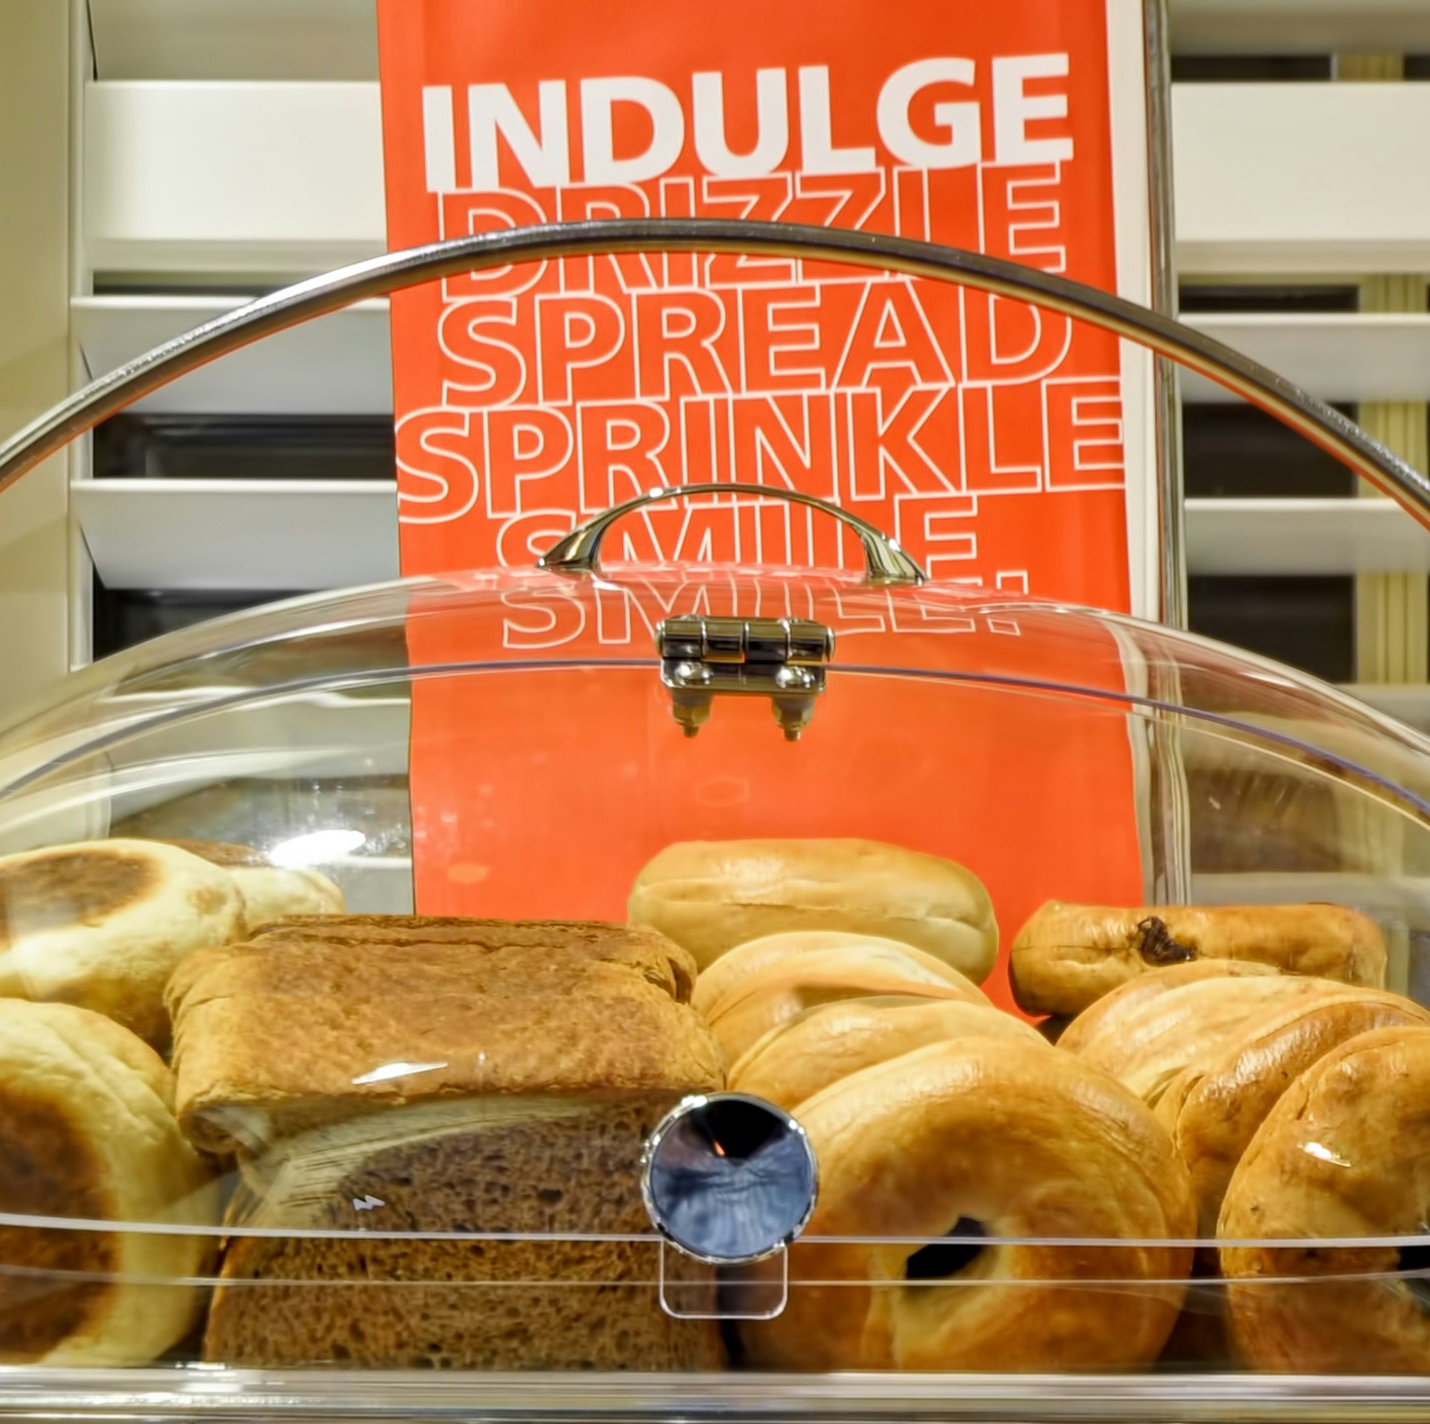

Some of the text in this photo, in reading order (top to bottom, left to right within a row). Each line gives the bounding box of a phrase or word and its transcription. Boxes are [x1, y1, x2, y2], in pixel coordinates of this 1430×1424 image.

[422, 53, 1074, 193] INDULGE
[438, 160, 1067, 303] DRIZZLE
[436, 277, 1073, 409] SPREAD
[393, 376, 1127, 524] SPRINKLE
